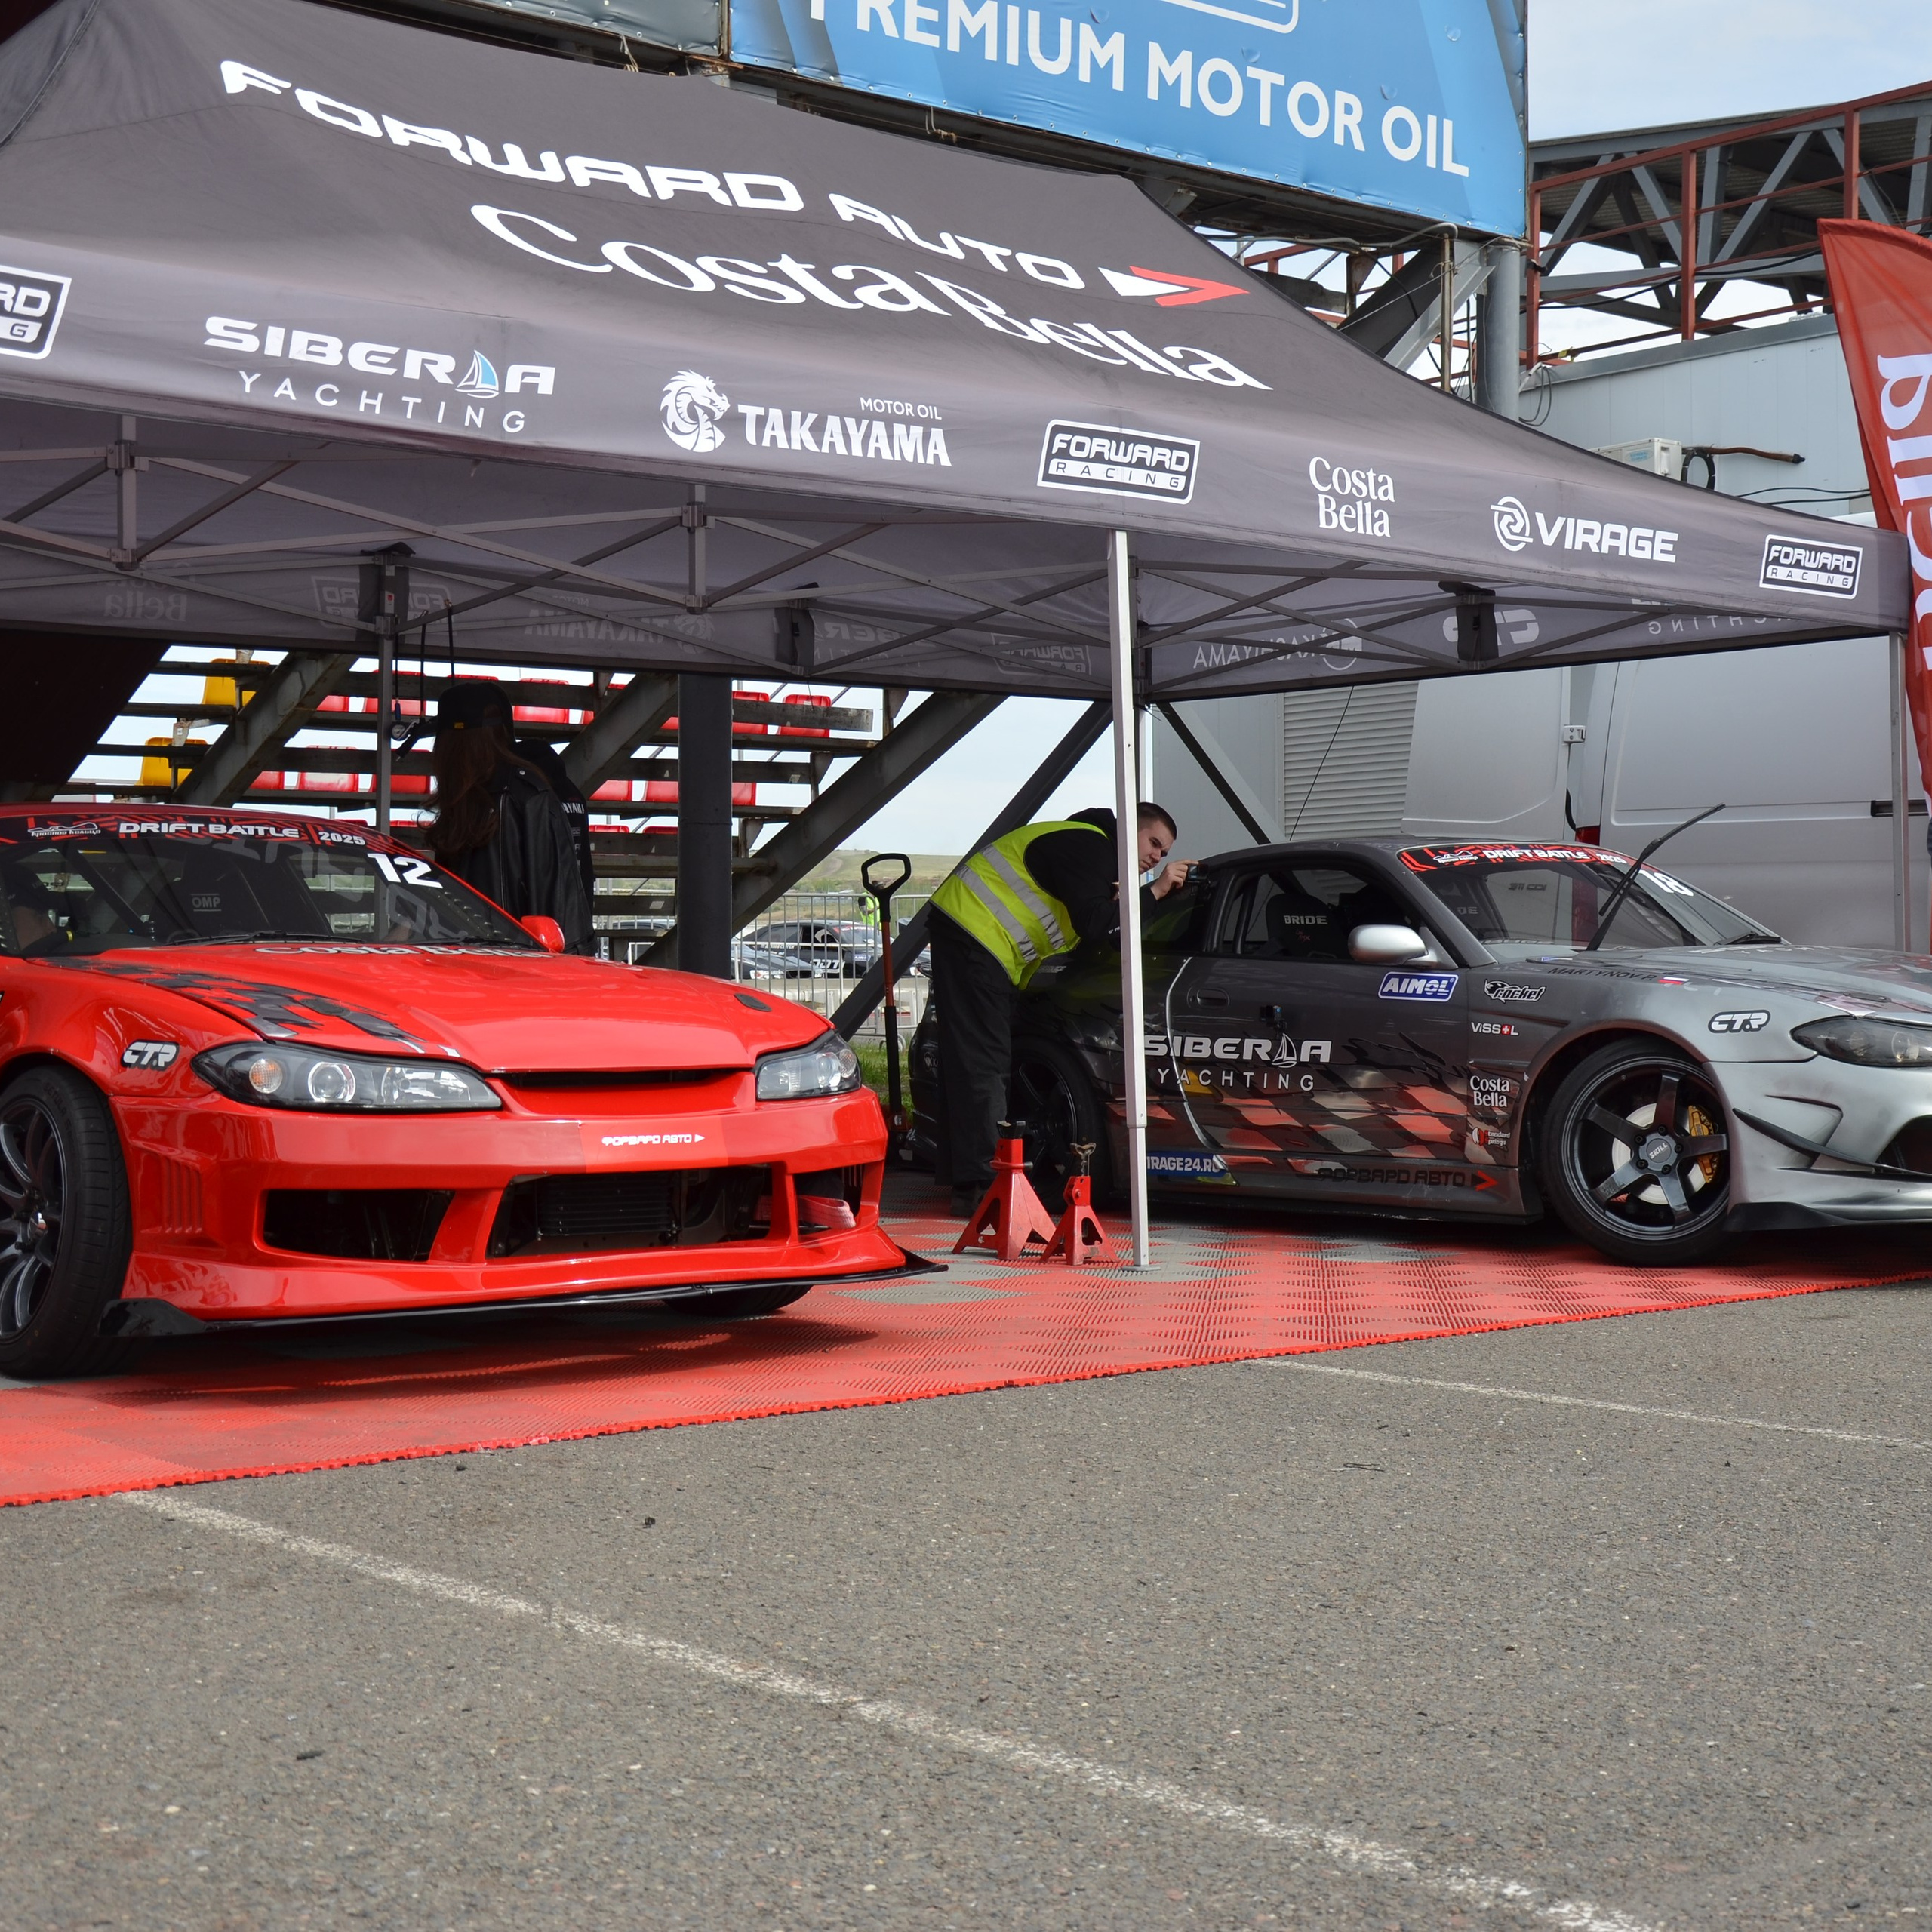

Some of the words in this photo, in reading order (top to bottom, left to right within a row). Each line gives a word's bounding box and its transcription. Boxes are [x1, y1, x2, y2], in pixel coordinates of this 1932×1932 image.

[1146, 40, 1366, 152] MOTOR
[1380, 104, 1469, 177] OIL
[220, 60, 804, 212] FORWARD
[829, 192, 1086, 290] AUTO
[470, 204, 952, 317] Costa
[915, 270, 1274, 390] Bella
[238, 370, 526, 433] YACHTING
[859, 396, 915, 417] MOTOR
[916, 402, 943, 420] OIL
[737, 403, 952, 467] TAKAYAMA
[1051, 432, 1190, 472] FORWARD
[1055, 462, 1180, 488] RACING
[1309, 457, 1396, 503] Costa
[1317, 494, 1392, 538] Bella
[1534, 512, 1679, 563] VIRAGE
[1768, 545, 1857, 574] FORWARD
[1770, 568, 1850, 587] RACING
[118, 823, 205, 834] DRIFT
[208, 823, 300, 838] BATTLE
[318, 831, 366, 846] 2025
[1482, 848, 1535, 859] DRIFT
[1536, 849, 1591, 860] BATTLE
[367, 853, 444, 889] 12
[1639, 869, 1694, 897] 18
[191, 896, 222, 909] OMP
[1283, 915, 1328, 924] BRIDE
[254, 944, 421, 955] Costa
[1382, 977, 1451, 995] AIMOL
[1547, 967, 1641, 980] MARTYNOV
[1157, 1068, 1314, 1091] YACHTING
[1469, 1075, 1510, 1092] Costa
[1473, 1091, 1508, 1108] Bella
[1648, 1142, 1669, 1160] SKILL
